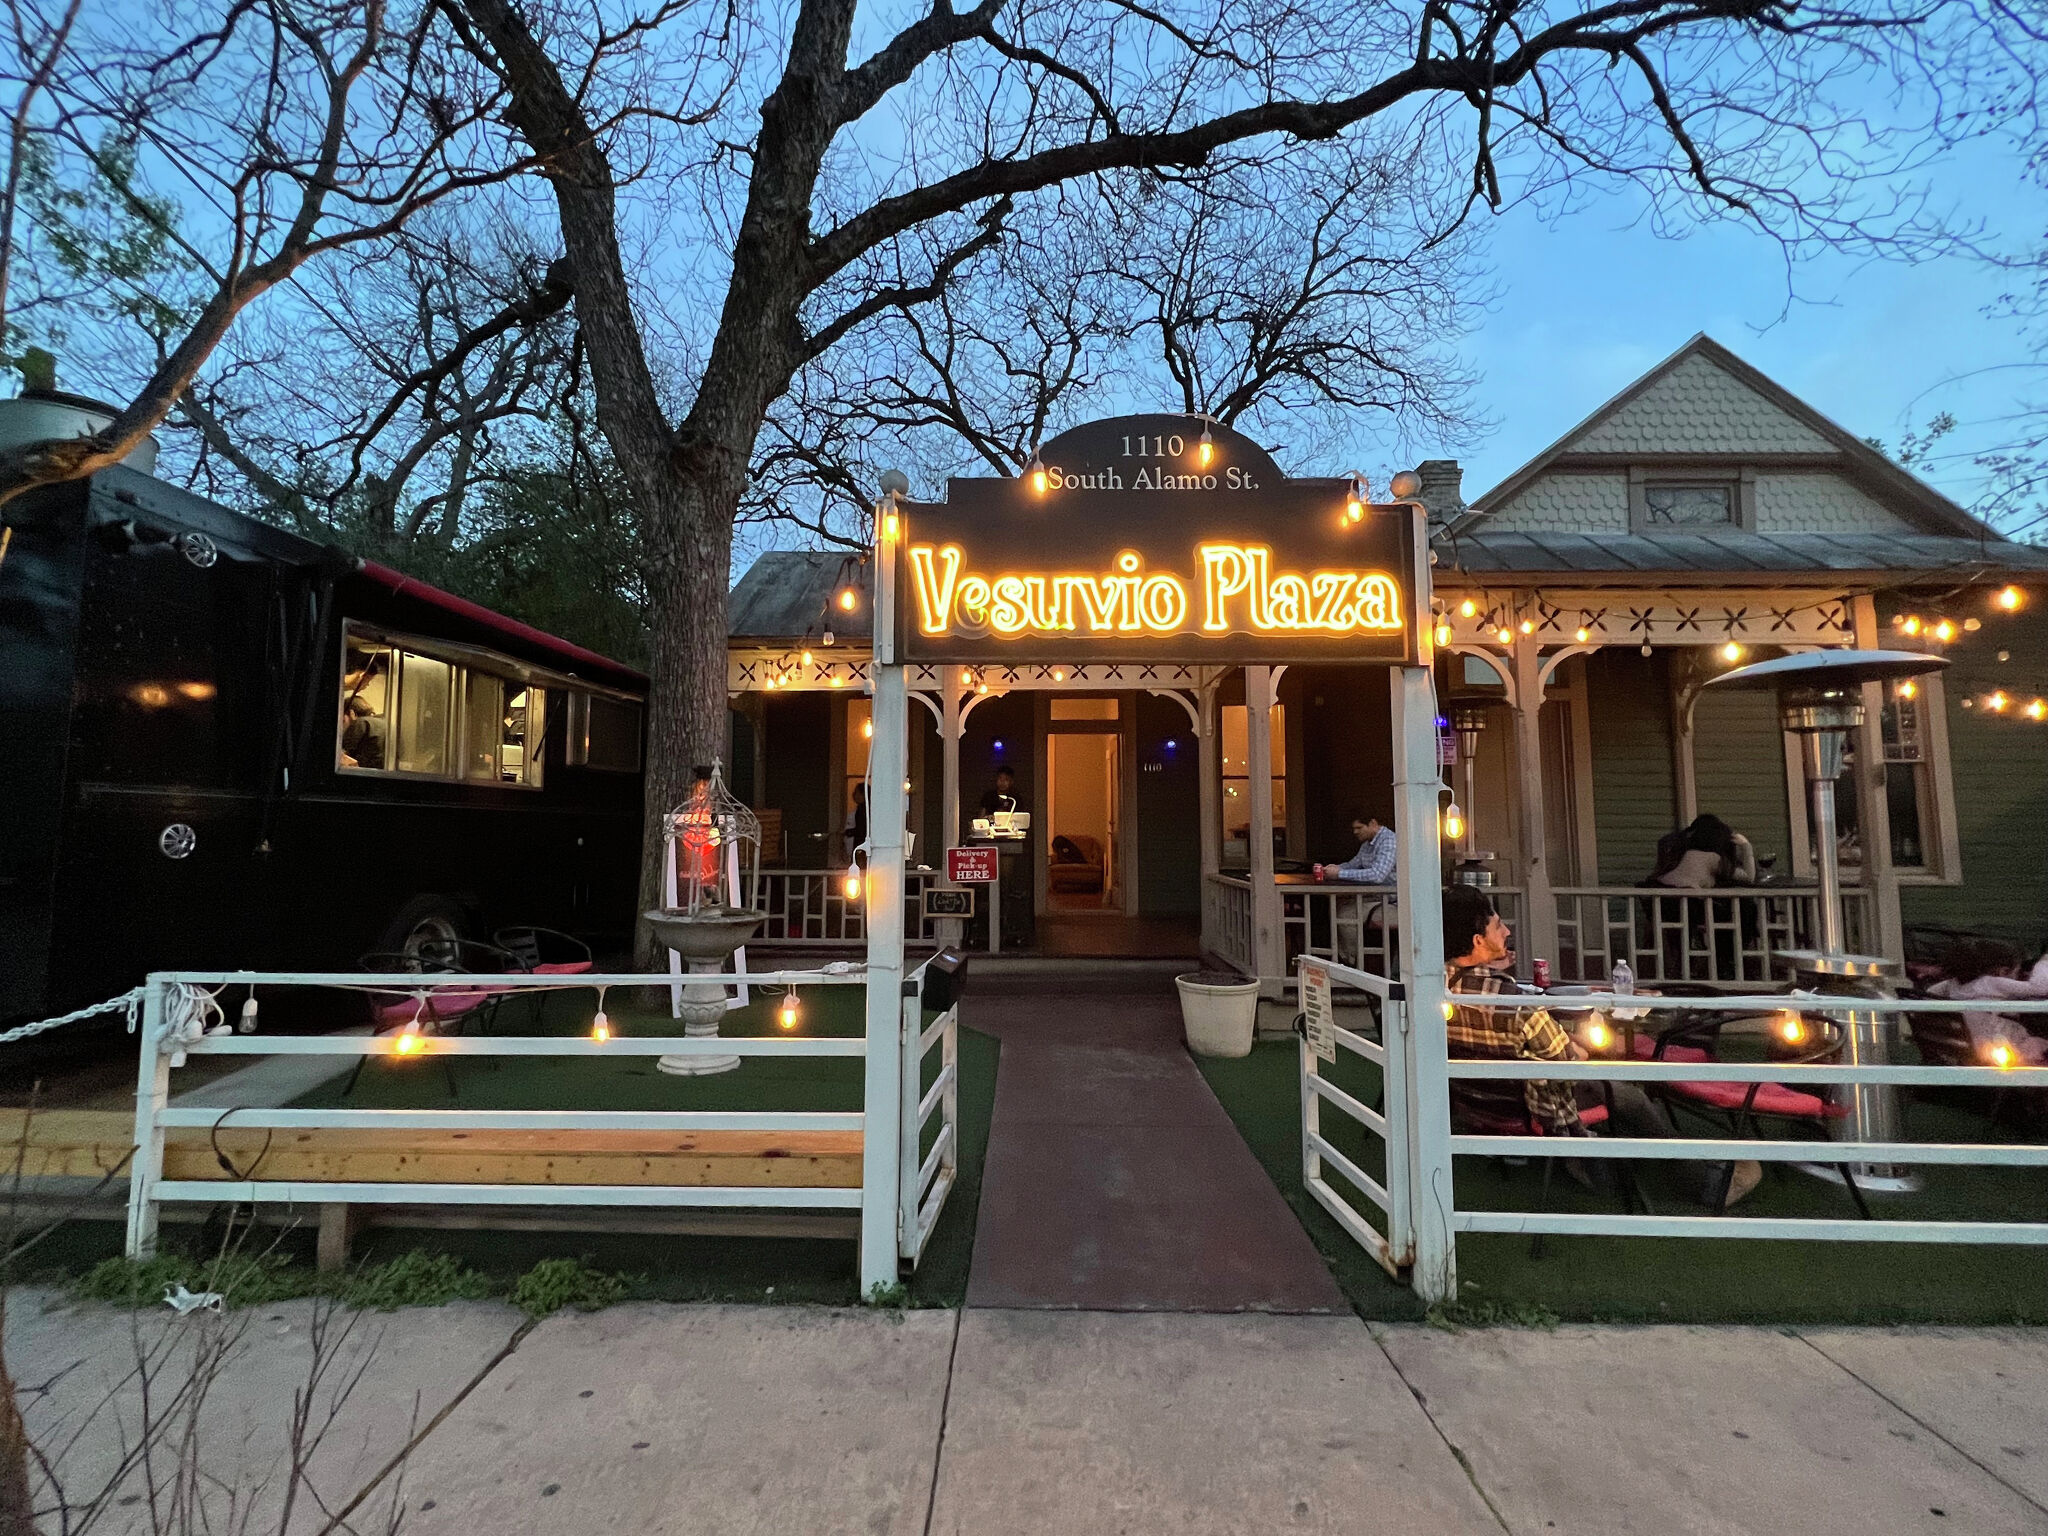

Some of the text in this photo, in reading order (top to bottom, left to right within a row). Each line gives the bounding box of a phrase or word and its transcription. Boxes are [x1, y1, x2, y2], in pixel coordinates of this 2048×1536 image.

[1122, 435, 1184, 457] 1110
[1047, 466, 1260, 490] South Alamo St.
[908, 544, 1404, 633] Vesuvio Plaza
[956, 850, 989, 858] Delivery
[956, 870, 990, 880] HERE
